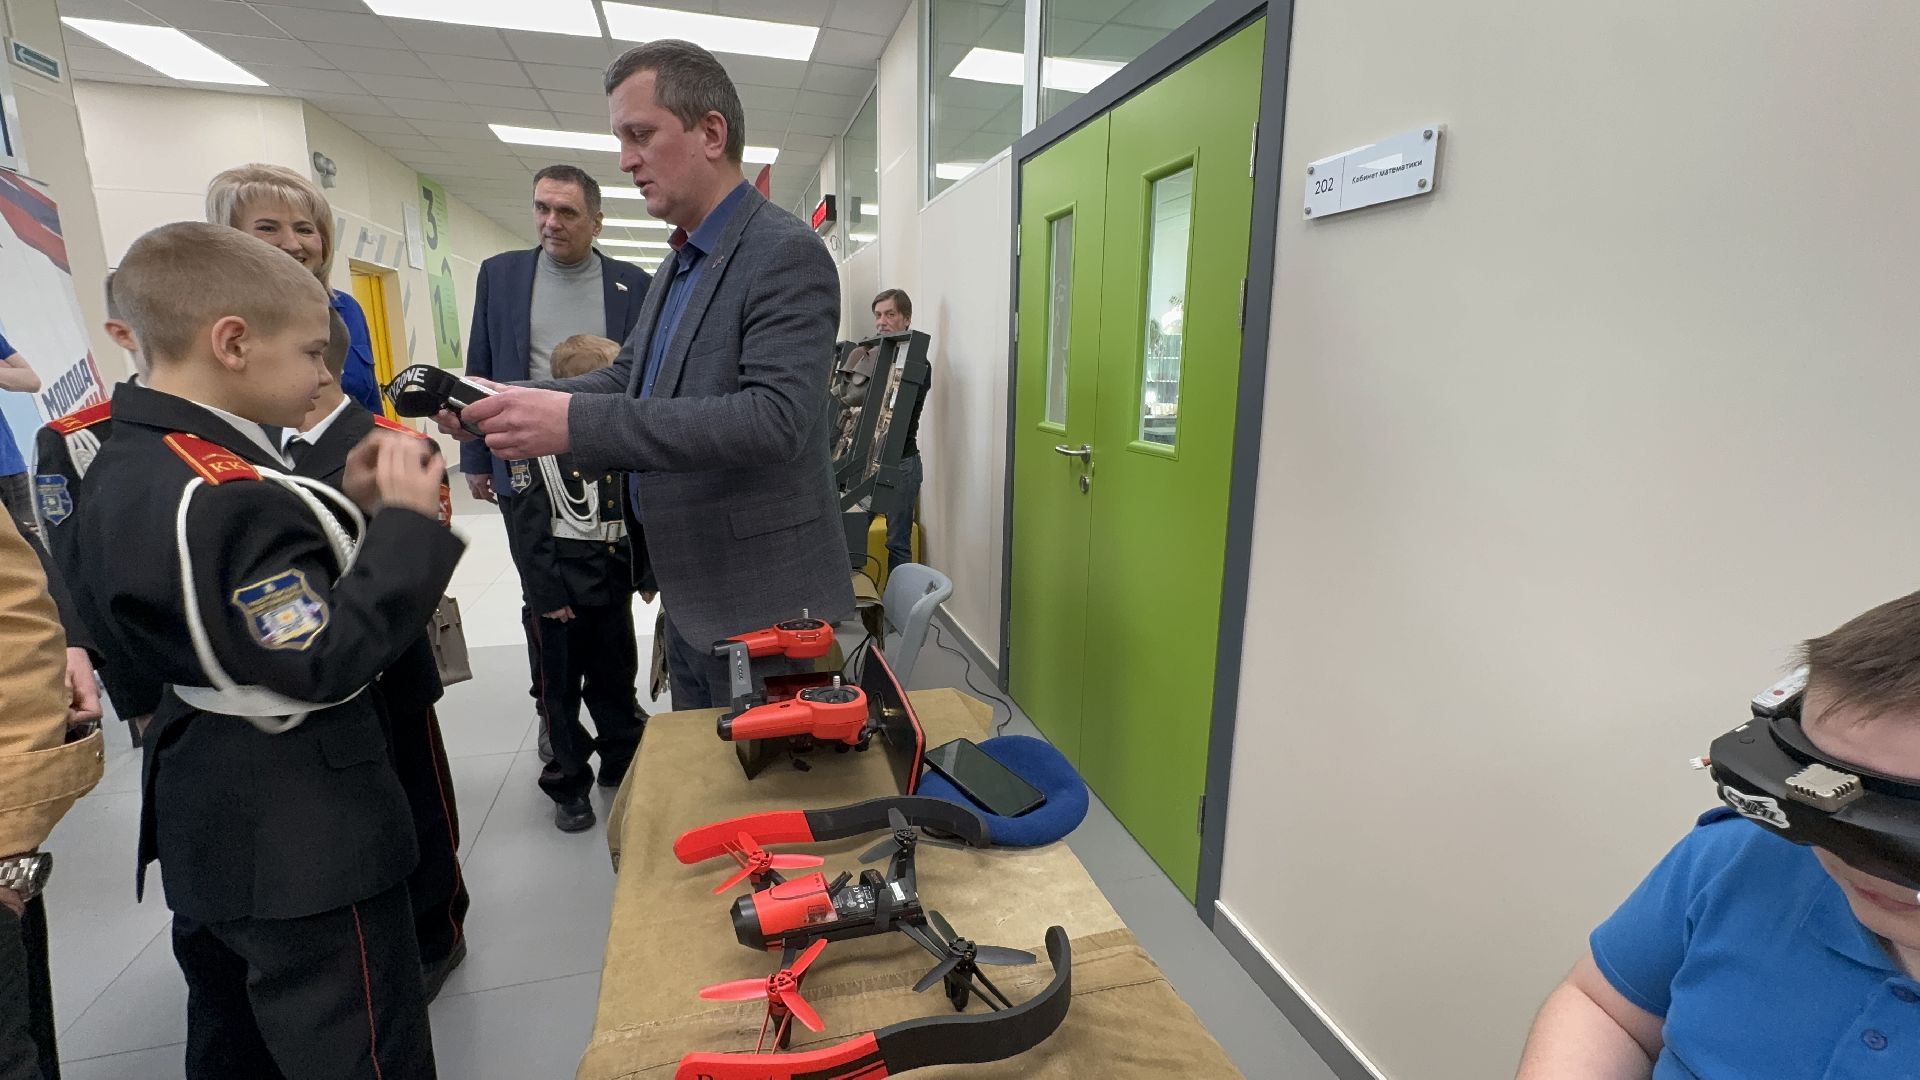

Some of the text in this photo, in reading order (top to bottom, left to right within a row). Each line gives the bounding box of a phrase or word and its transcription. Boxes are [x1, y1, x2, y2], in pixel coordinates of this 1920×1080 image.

[1351, 159, 1423, 185] Кабинет математики
[1314, 177, 1334, 195] 202
